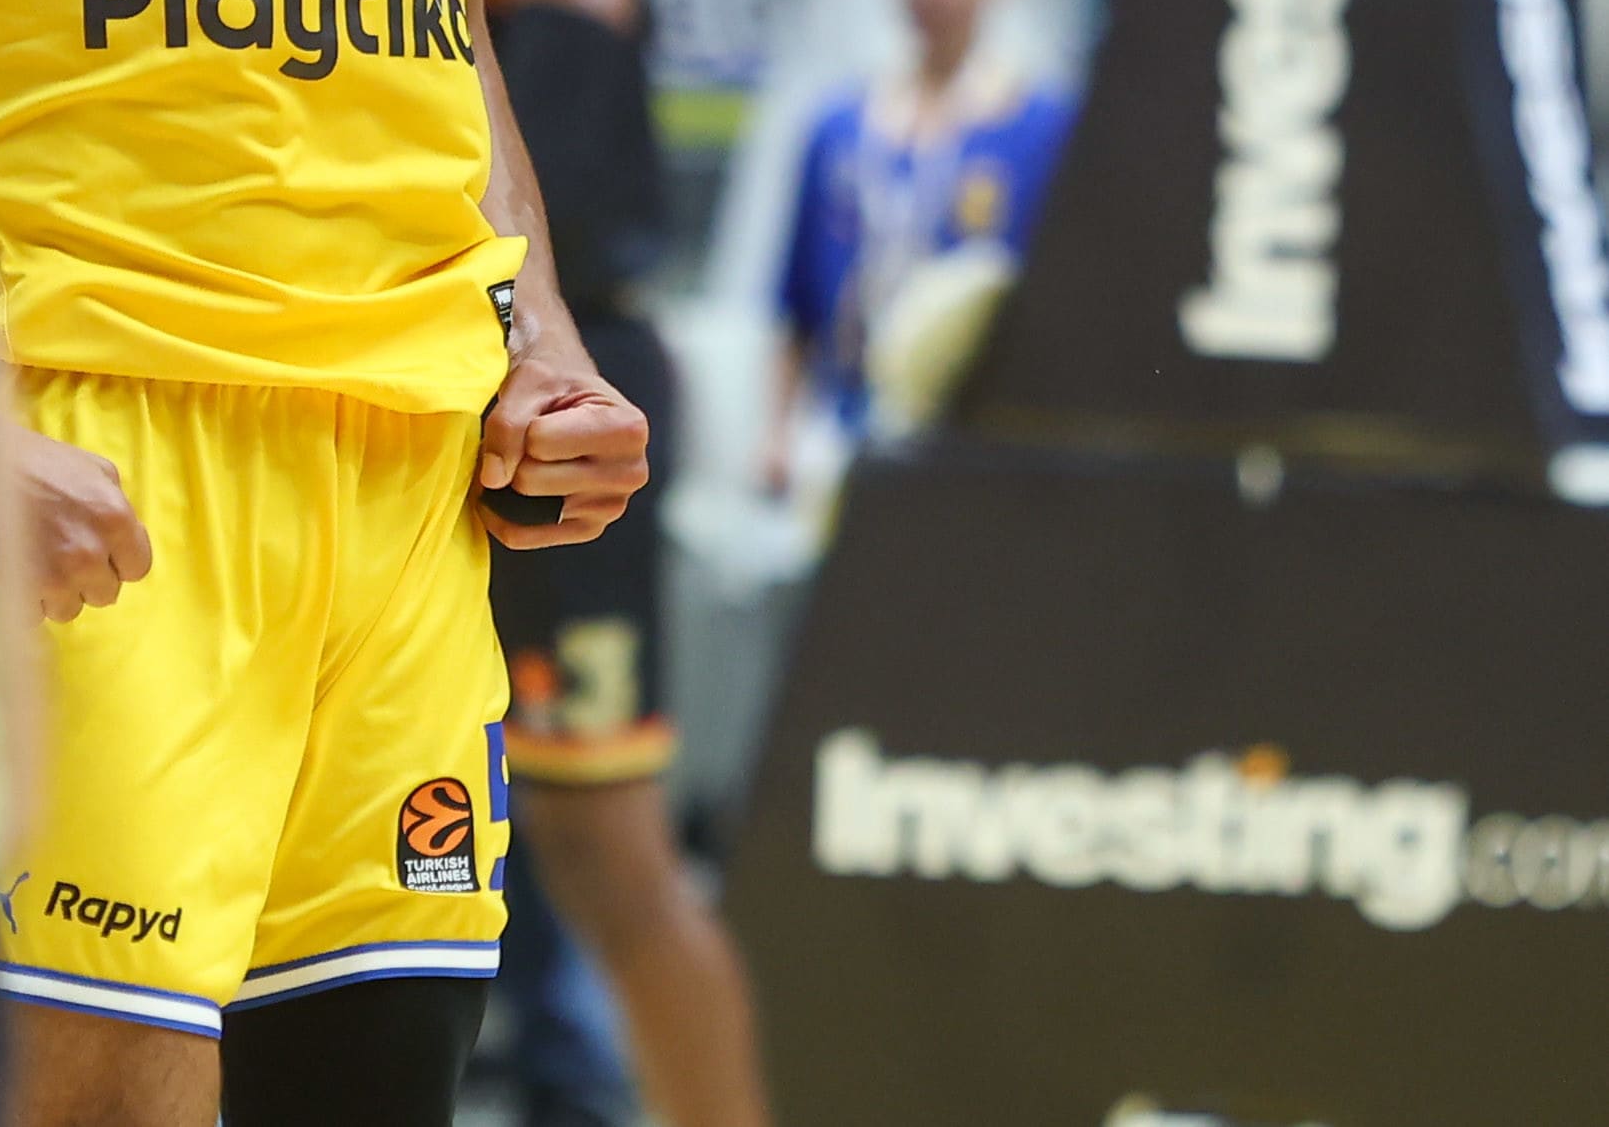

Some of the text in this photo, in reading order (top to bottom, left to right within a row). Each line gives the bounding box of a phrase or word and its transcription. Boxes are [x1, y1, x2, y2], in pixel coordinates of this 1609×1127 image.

[812, 725, 1609, 932] Investing.co
[404, 856, 469, 872] TURKISH
[407, 869, 471, 884] AIRLINES
[44, 881, 182, 943] Rapyd
